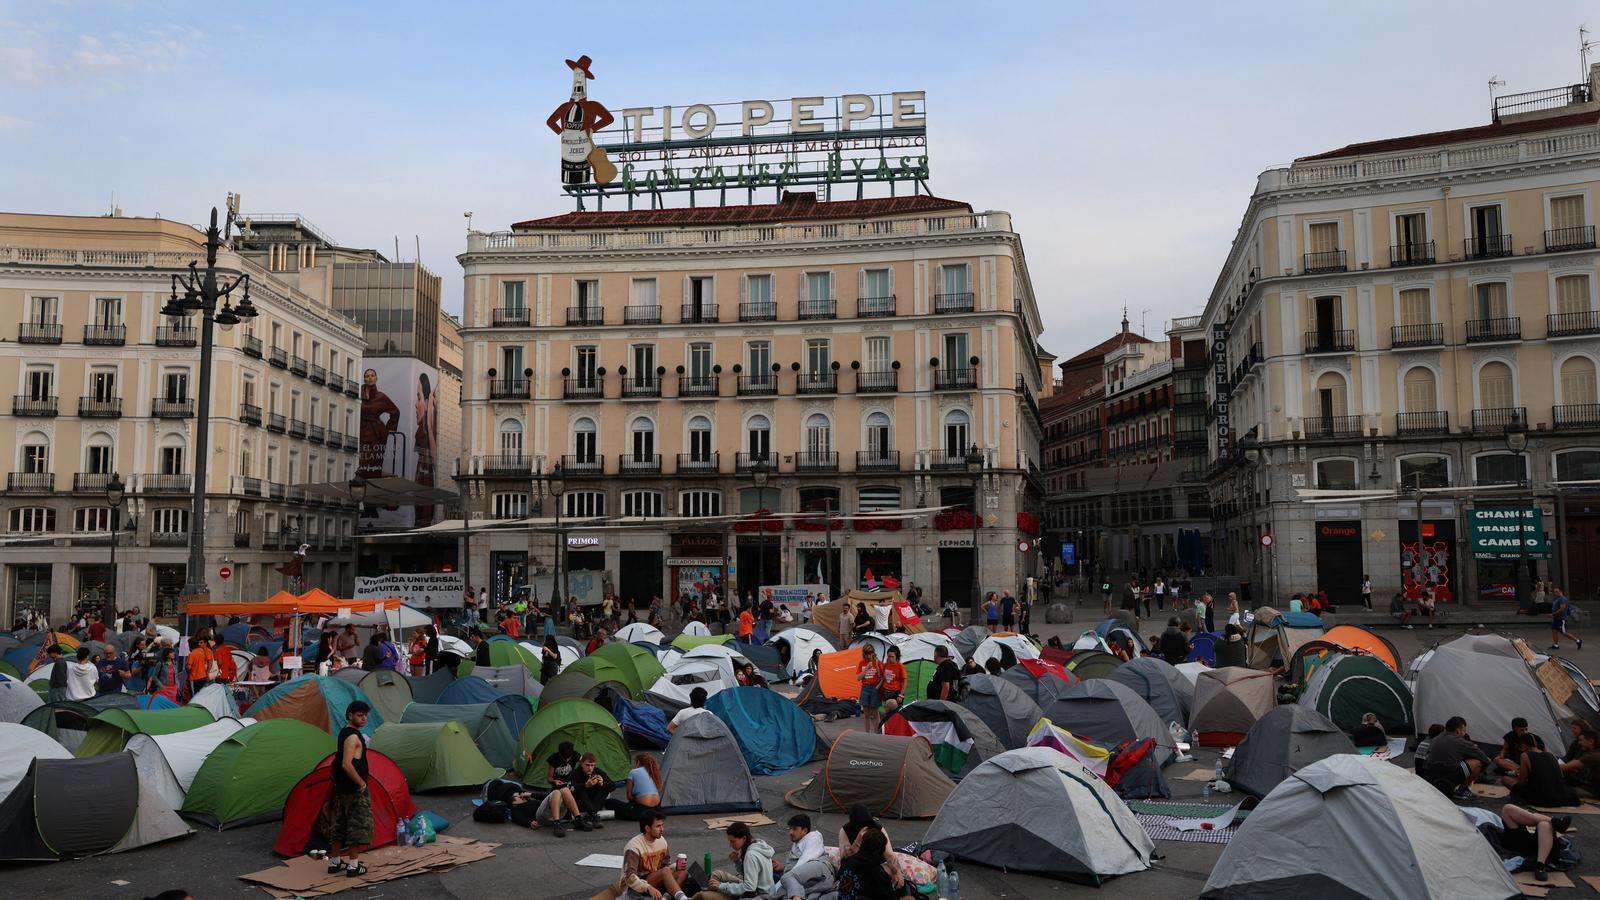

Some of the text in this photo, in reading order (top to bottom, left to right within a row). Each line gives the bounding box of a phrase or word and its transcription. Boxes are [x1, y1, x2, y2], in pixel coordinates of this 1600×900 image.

[622, 91, 926, 143] TIO PEPE
[618, 151, 652, 163] SOL
[659, 149, 680, 160] DE
[792, 136, 926, 152] EMBOTELLADO
[622, 151, 929, 192] GONZALEZ BYASS
[1215, 330, 1229, 459] HOTEL EUROPA
[1321, 526, 1356, 536] Orange
[567, 536, 599, 545] PRIMOR
[358, 585, 401, 594] GRATUITA
[849, 759, 884, 767] Quechua
